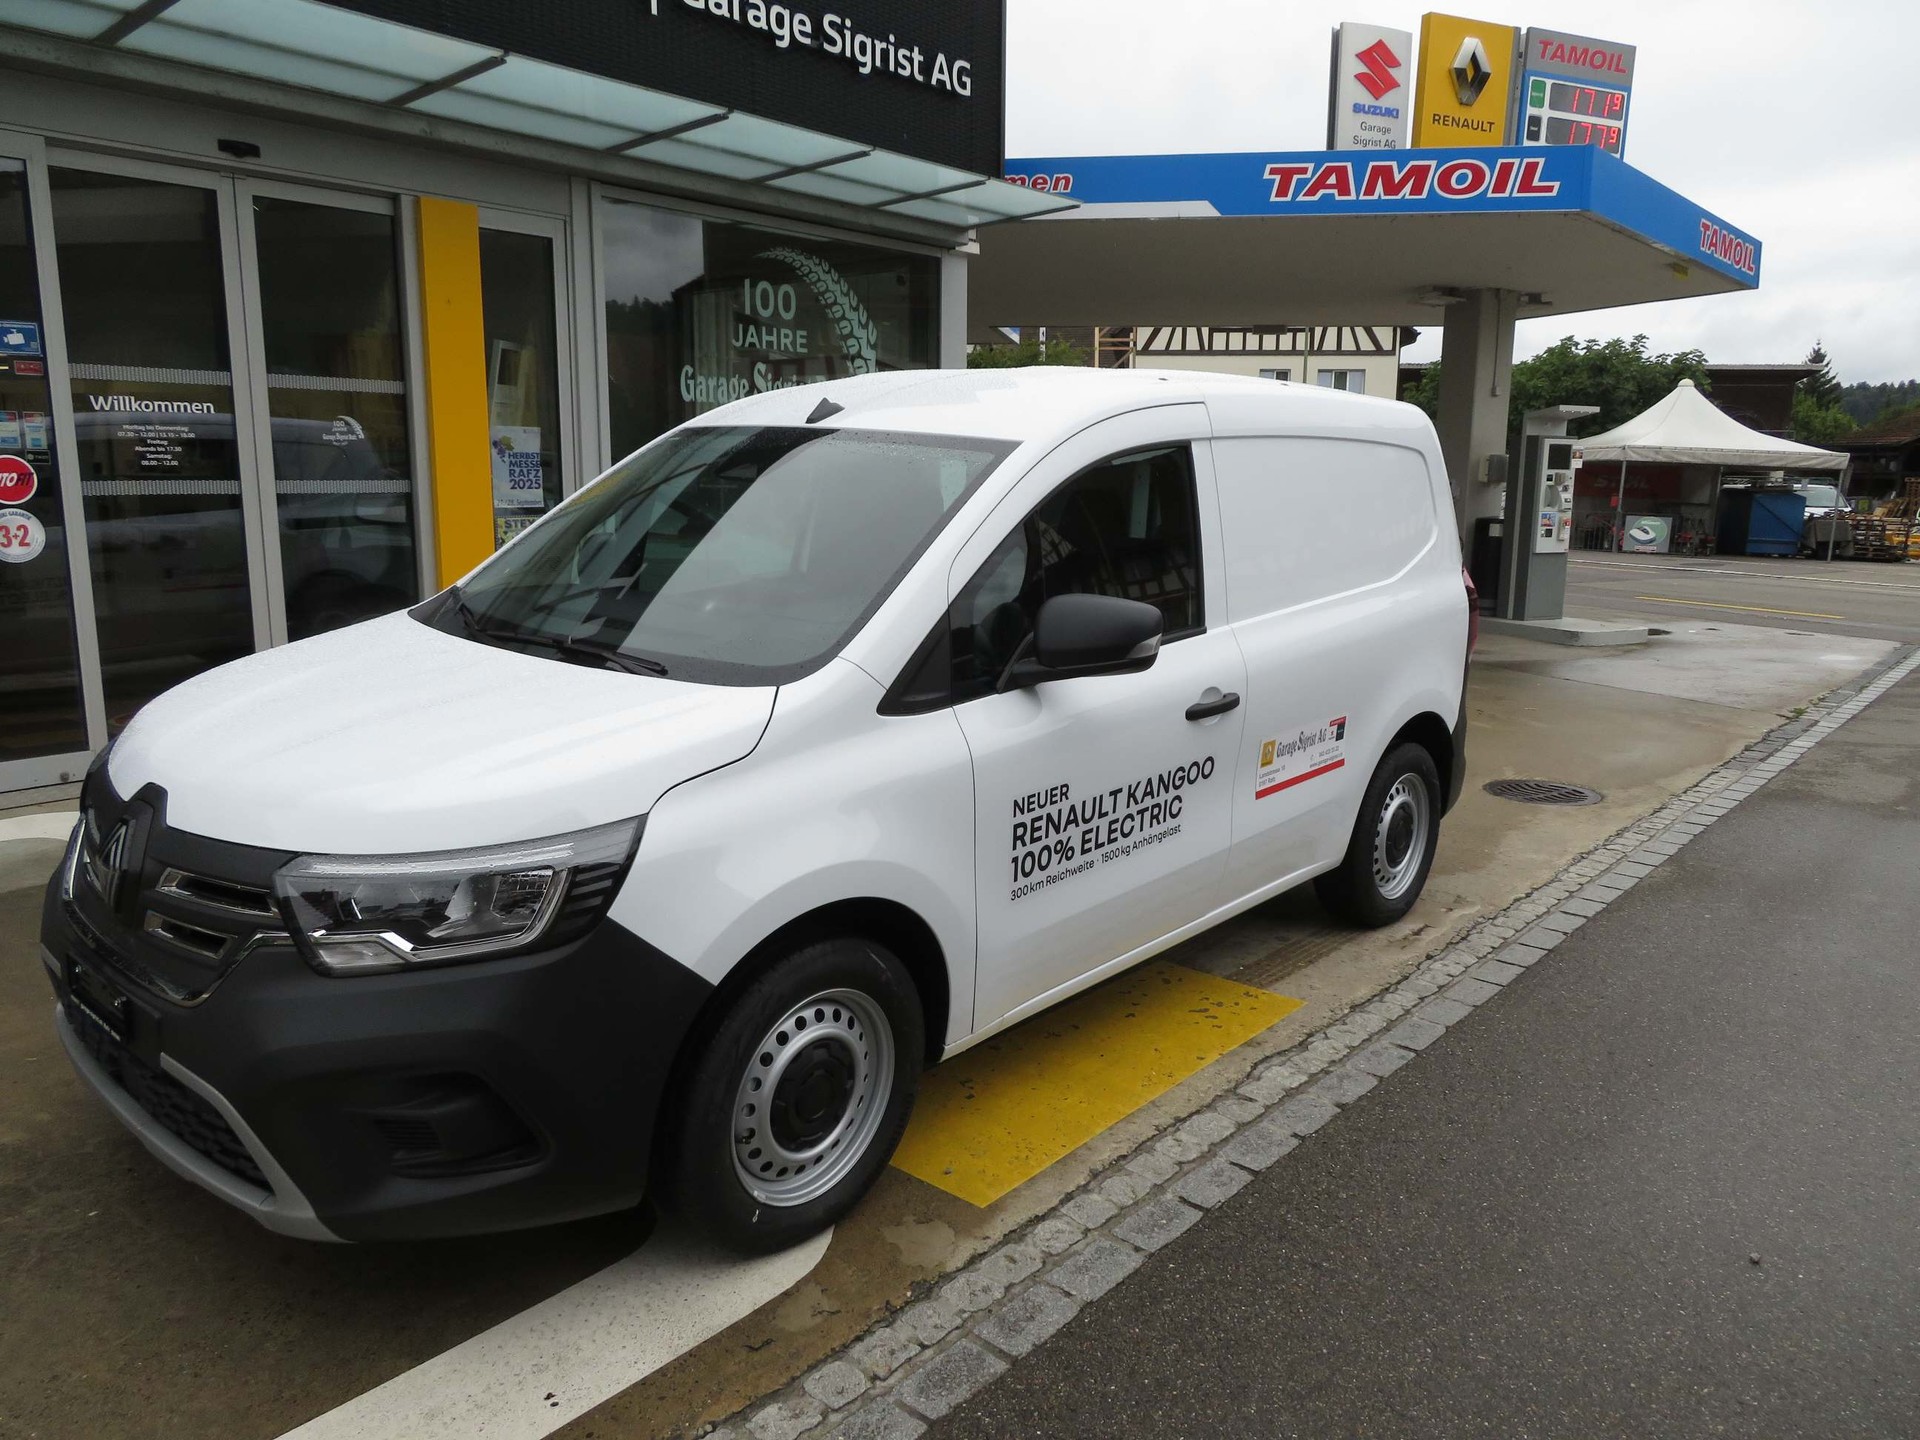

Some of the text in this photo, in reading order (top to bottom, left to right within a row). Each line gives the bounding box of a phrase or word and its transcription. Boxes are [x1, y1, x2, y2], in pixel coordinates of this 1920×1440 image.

[822, 13, 924, 82] Sigrist
[930, 52, 972, 97] AG
[1538, 39, 1628, 74] TAMOIL
[1352, 103, 1399, 119] SUZUKI
[1432, 113, 1495, 133] RENAULT
[1352, 135, 1396, 149] Sigrist AG
[1360, 121, 1392, 135] Garage
[1263, 157, 1560, 202] TAMOIL
[1700, 218, 1755, 275] TAMOIL
[744, 278, 796, 320] 100
[732, 323, 808, 353] JAHRE
[680, 364, 749, 402] Garage
[89, 395, 215, 414] Willkommen
[508, 452, 541, 460] HERBST
[509, 460, 541, 469] MESSE
[509, 469, 541, 478] RAFZ
[510, 478, 542, 490] 2025
[1276, 740, 1297, 758] Garage
[1297, 731, 1317, 752] Sigrist
[1317, 728, 1327, 744] AG
[1012, 756, 1215, 851] RENAULT KANGOO
[1013, 783, 1070, 818] NEUER
[1011, 795, 1183, 883] 100% ELECTRIC
[1046, 859, 1095, 887] Reichweite
[1132, 824, 1181, 851] Anhängelast
